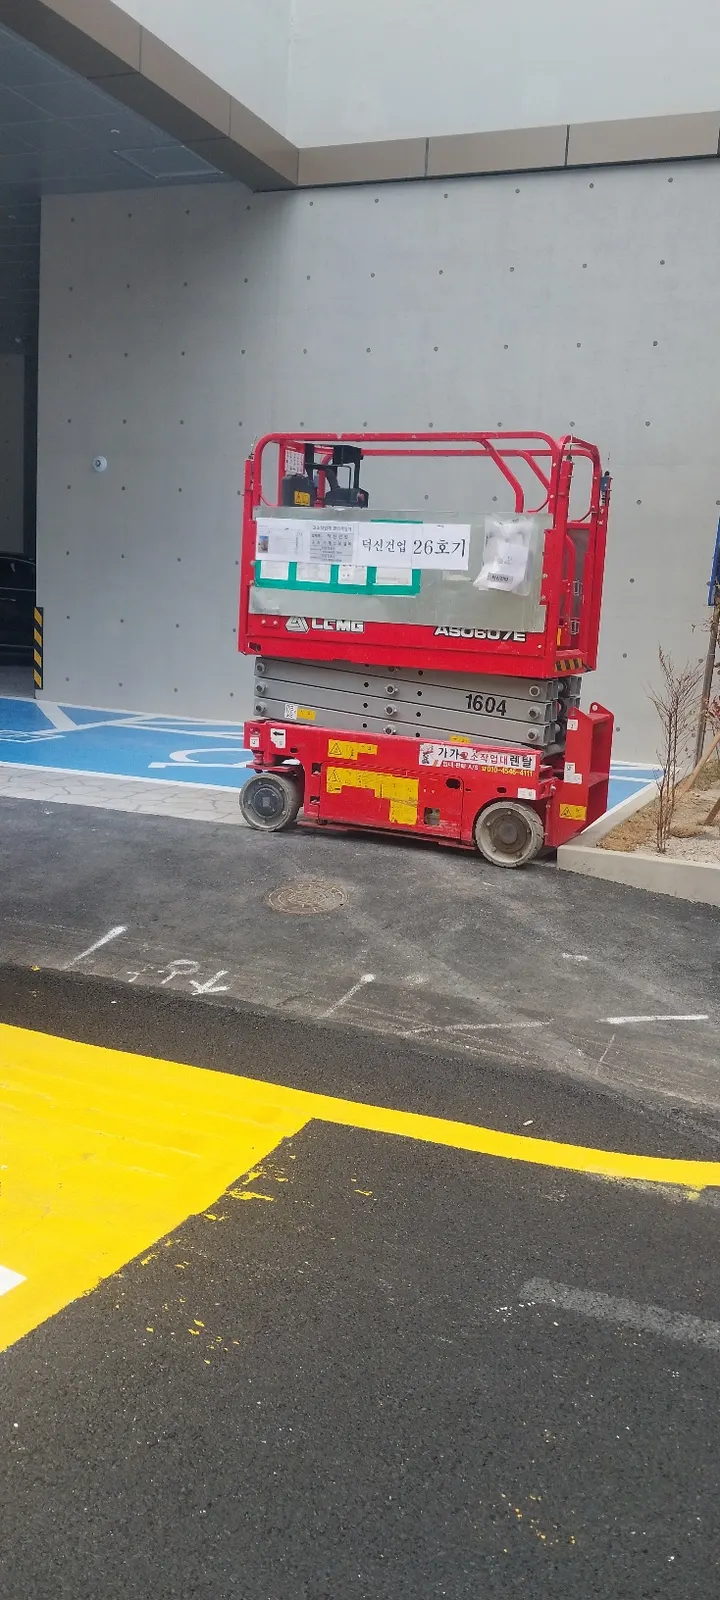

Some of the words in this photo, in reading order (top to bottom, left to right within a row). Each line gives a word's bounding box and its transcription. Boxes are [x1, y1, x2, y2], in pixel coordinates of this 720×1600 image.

[362, 538, 406, 553] 덕신건업
[413, 538, 466, 558] 26호기
[465, 693, 507, 716] 1604
